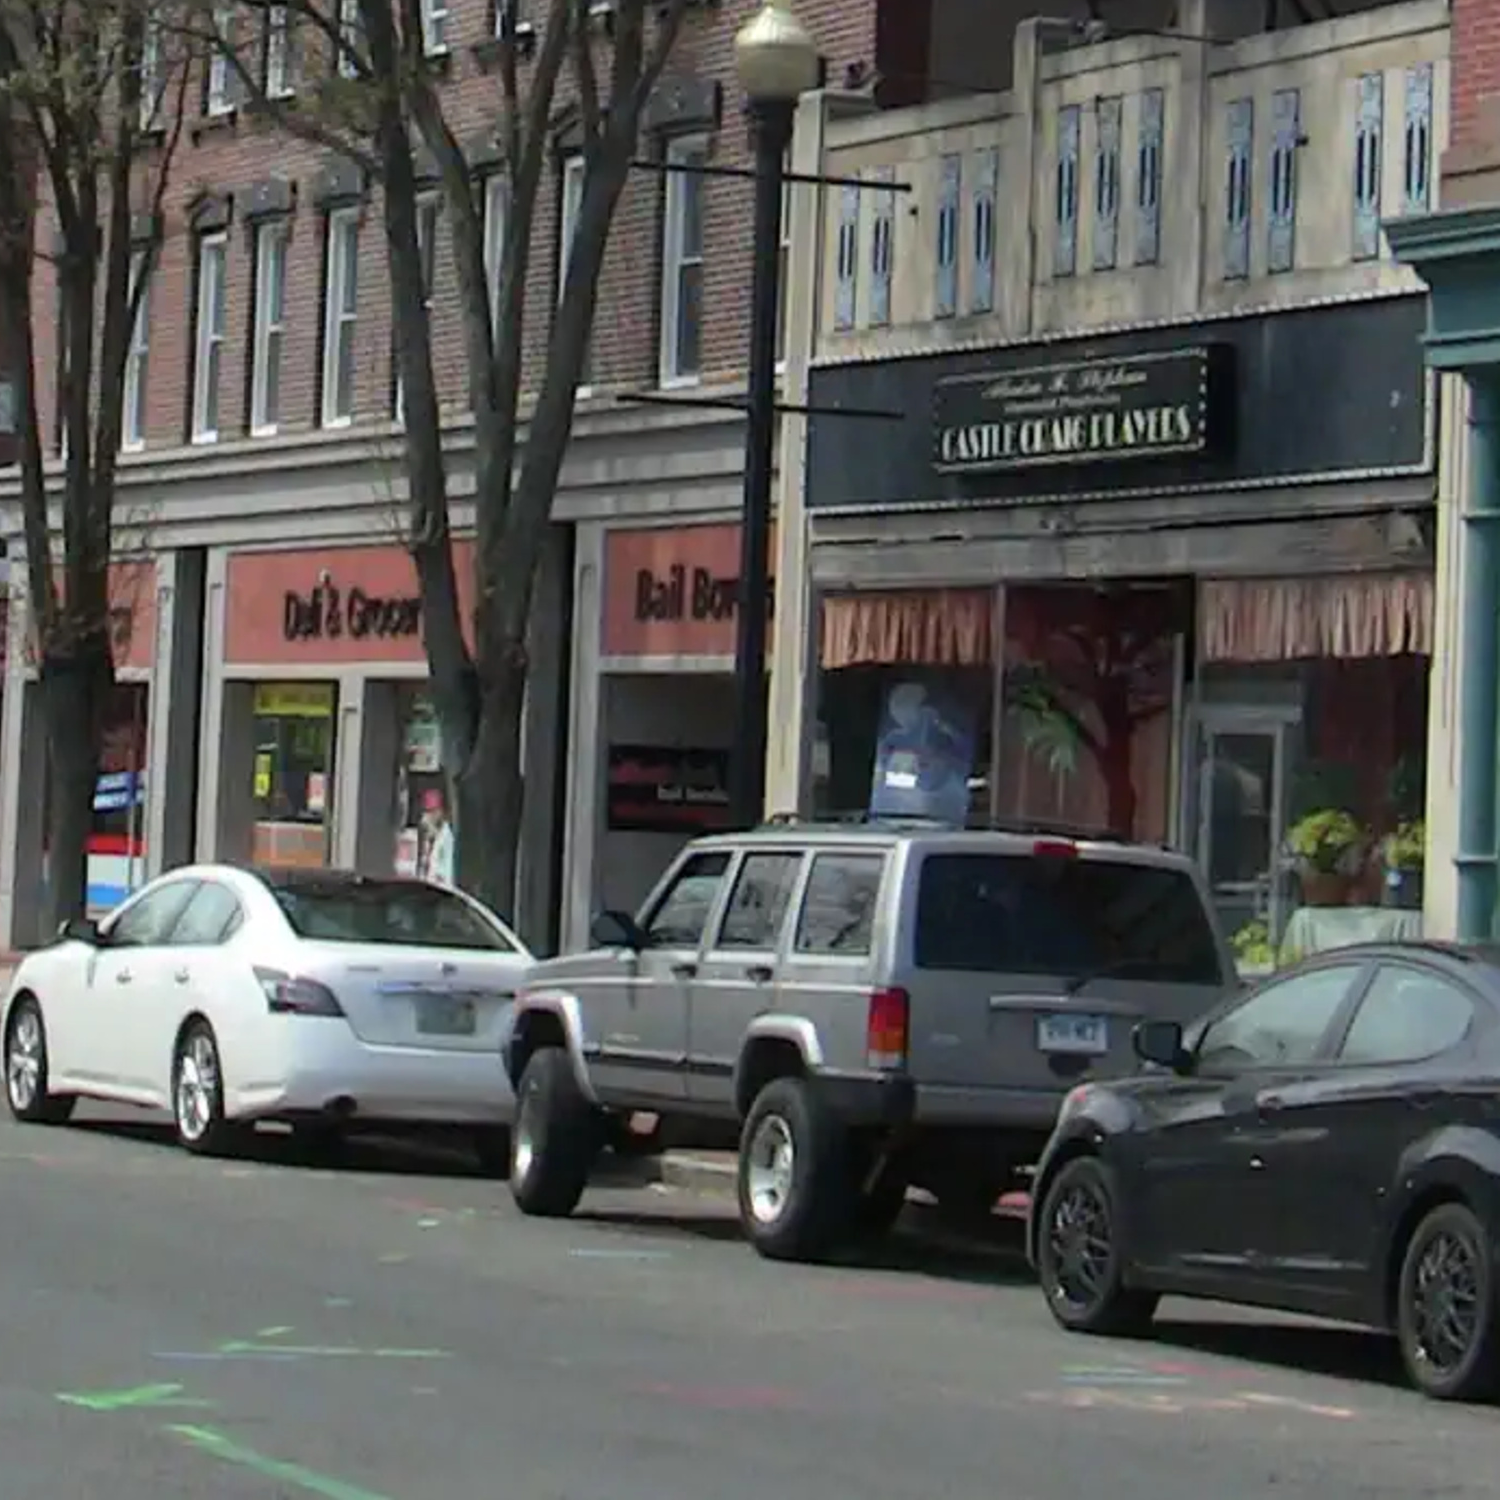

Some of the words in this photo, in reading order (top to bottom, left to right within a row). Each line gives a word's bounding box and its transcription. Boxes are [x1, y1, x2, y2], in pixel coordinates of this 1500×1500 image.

[942, 424, 1017, 461] CASTLE
[1020, 415, 1083, 451] CRAIG
[1089, 404, 1191, 448] PLAYERS
[348, 586, 420, 640] Grocer
[636, 564, 685, 622] Bail
